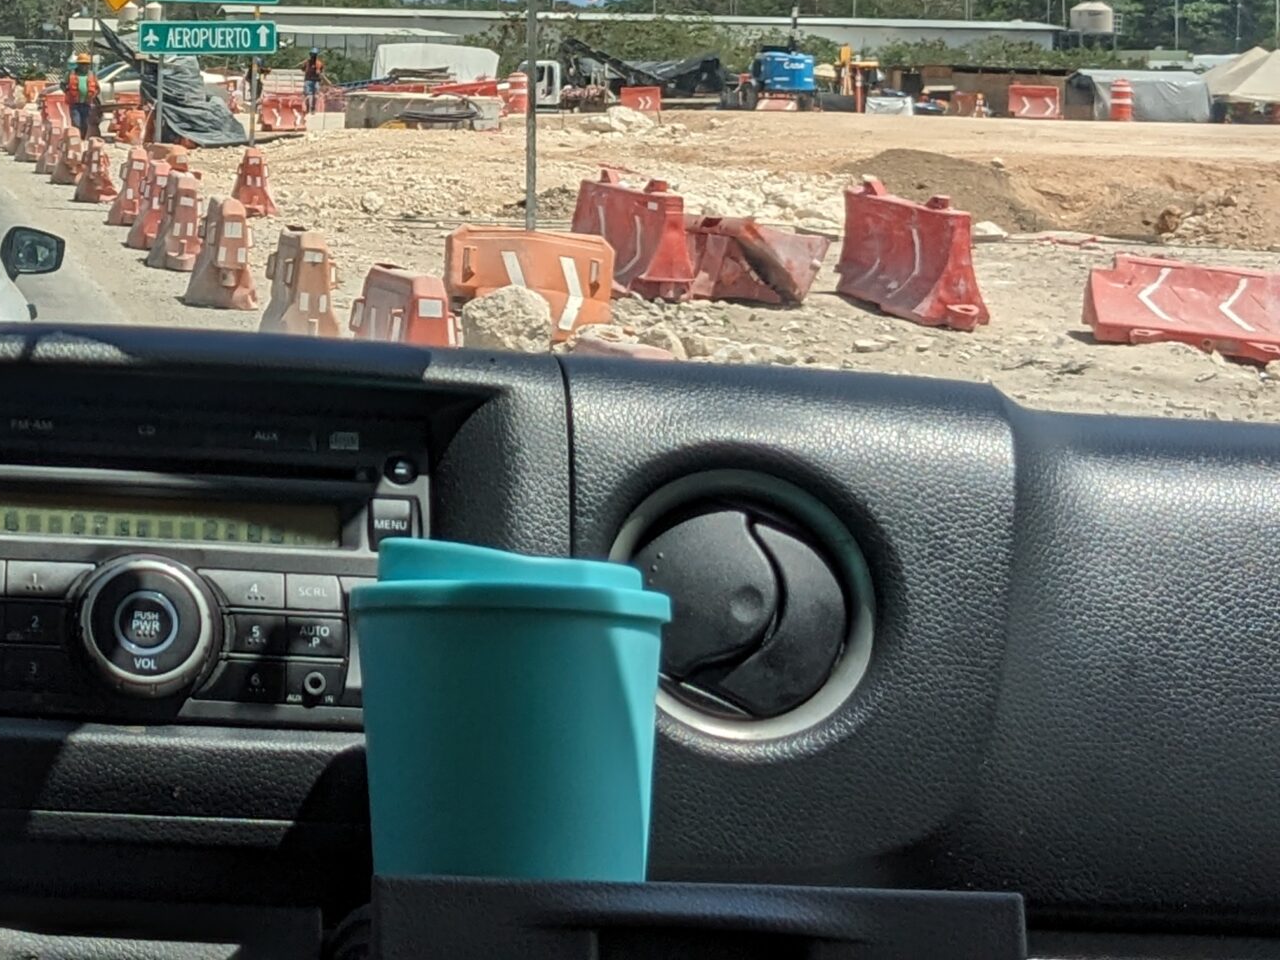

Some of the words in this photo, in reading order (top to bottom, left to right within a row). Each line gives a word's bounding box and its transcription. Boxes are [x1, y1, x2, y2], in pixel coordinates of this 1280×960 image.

[166, 27, 251, 48] AEROPUERTO
[253, 430, 279, 441] AUX
[374, 519, 407, 531] MENU
[250, 583, 258, 593] 4
[298, 587, 328, 598] SCRL
[31, 615, 40, 628] 2
[133, 610, 160, 621] PUSH
[132, 620, 161, 632] PWR
[251, 625, 260, 638] 5
[299, 626, 330, 638] AUTO
[28, 661, 37, 674] 3
[133, 657, 158, 669] VOL
[251, 672, 261, 686] 6
[325, 695, 334, 704] IN
